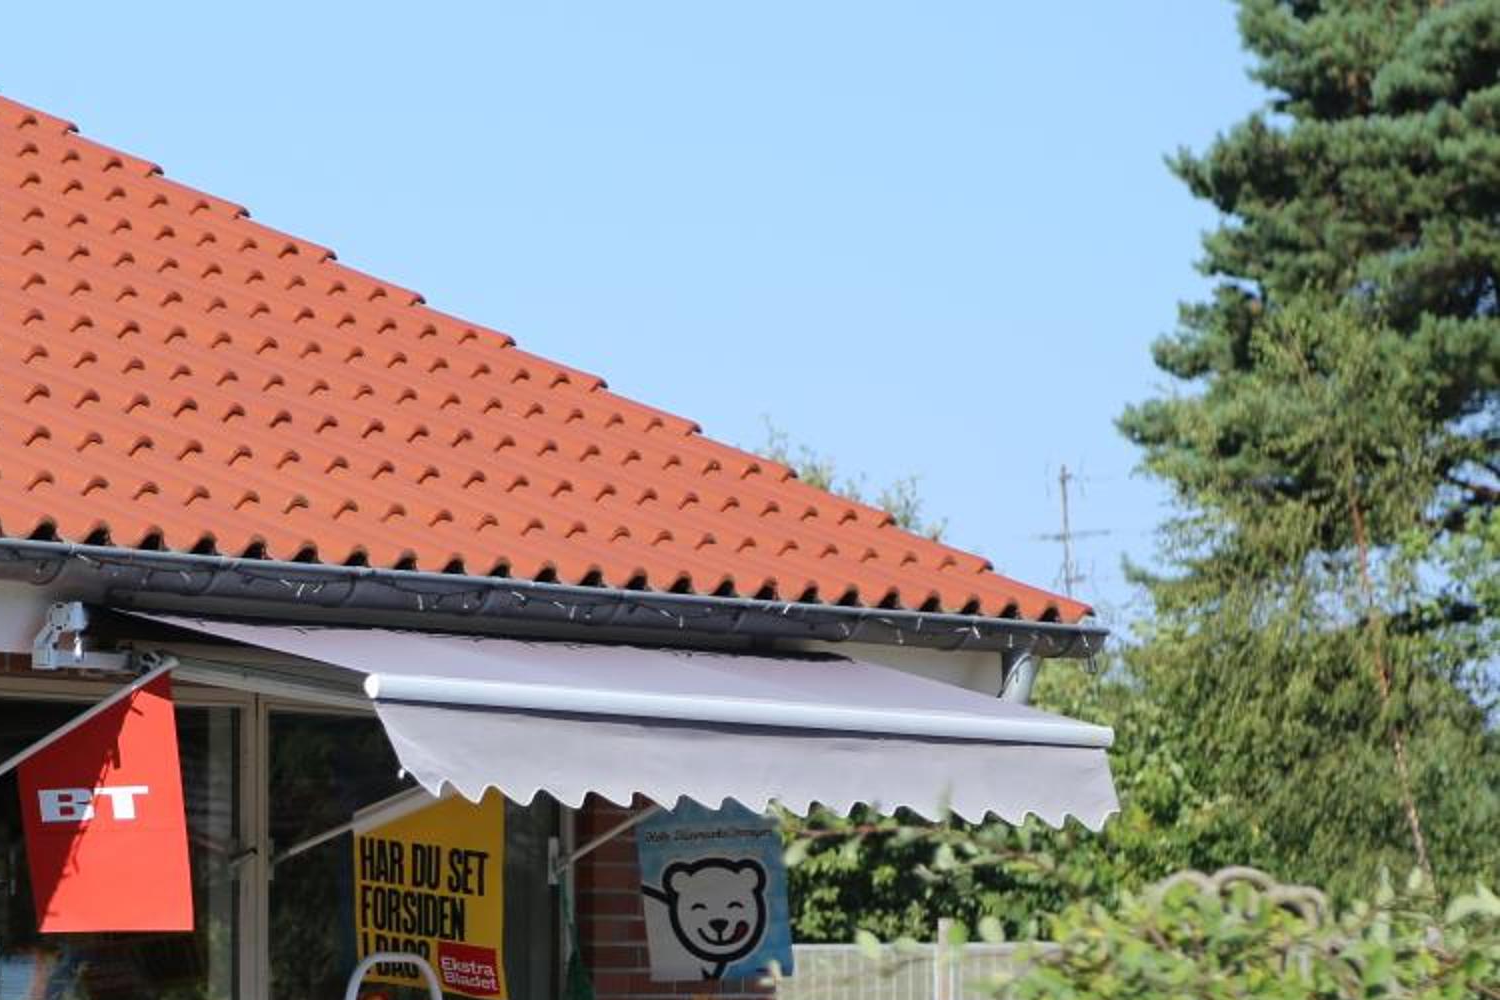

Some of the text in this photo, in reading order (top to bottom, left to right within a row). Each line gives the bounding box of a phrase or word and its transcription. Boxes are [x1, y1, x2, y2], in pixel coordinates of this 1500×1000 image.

[37, 785, 149, 822] BT
[360, 836, 489, 896] HAR DU SET
[360, 885, 466, 942] FORSIDEN
[441, 956, 495, 977] Ekstra
[444, 971, 498, 990] Bladet
